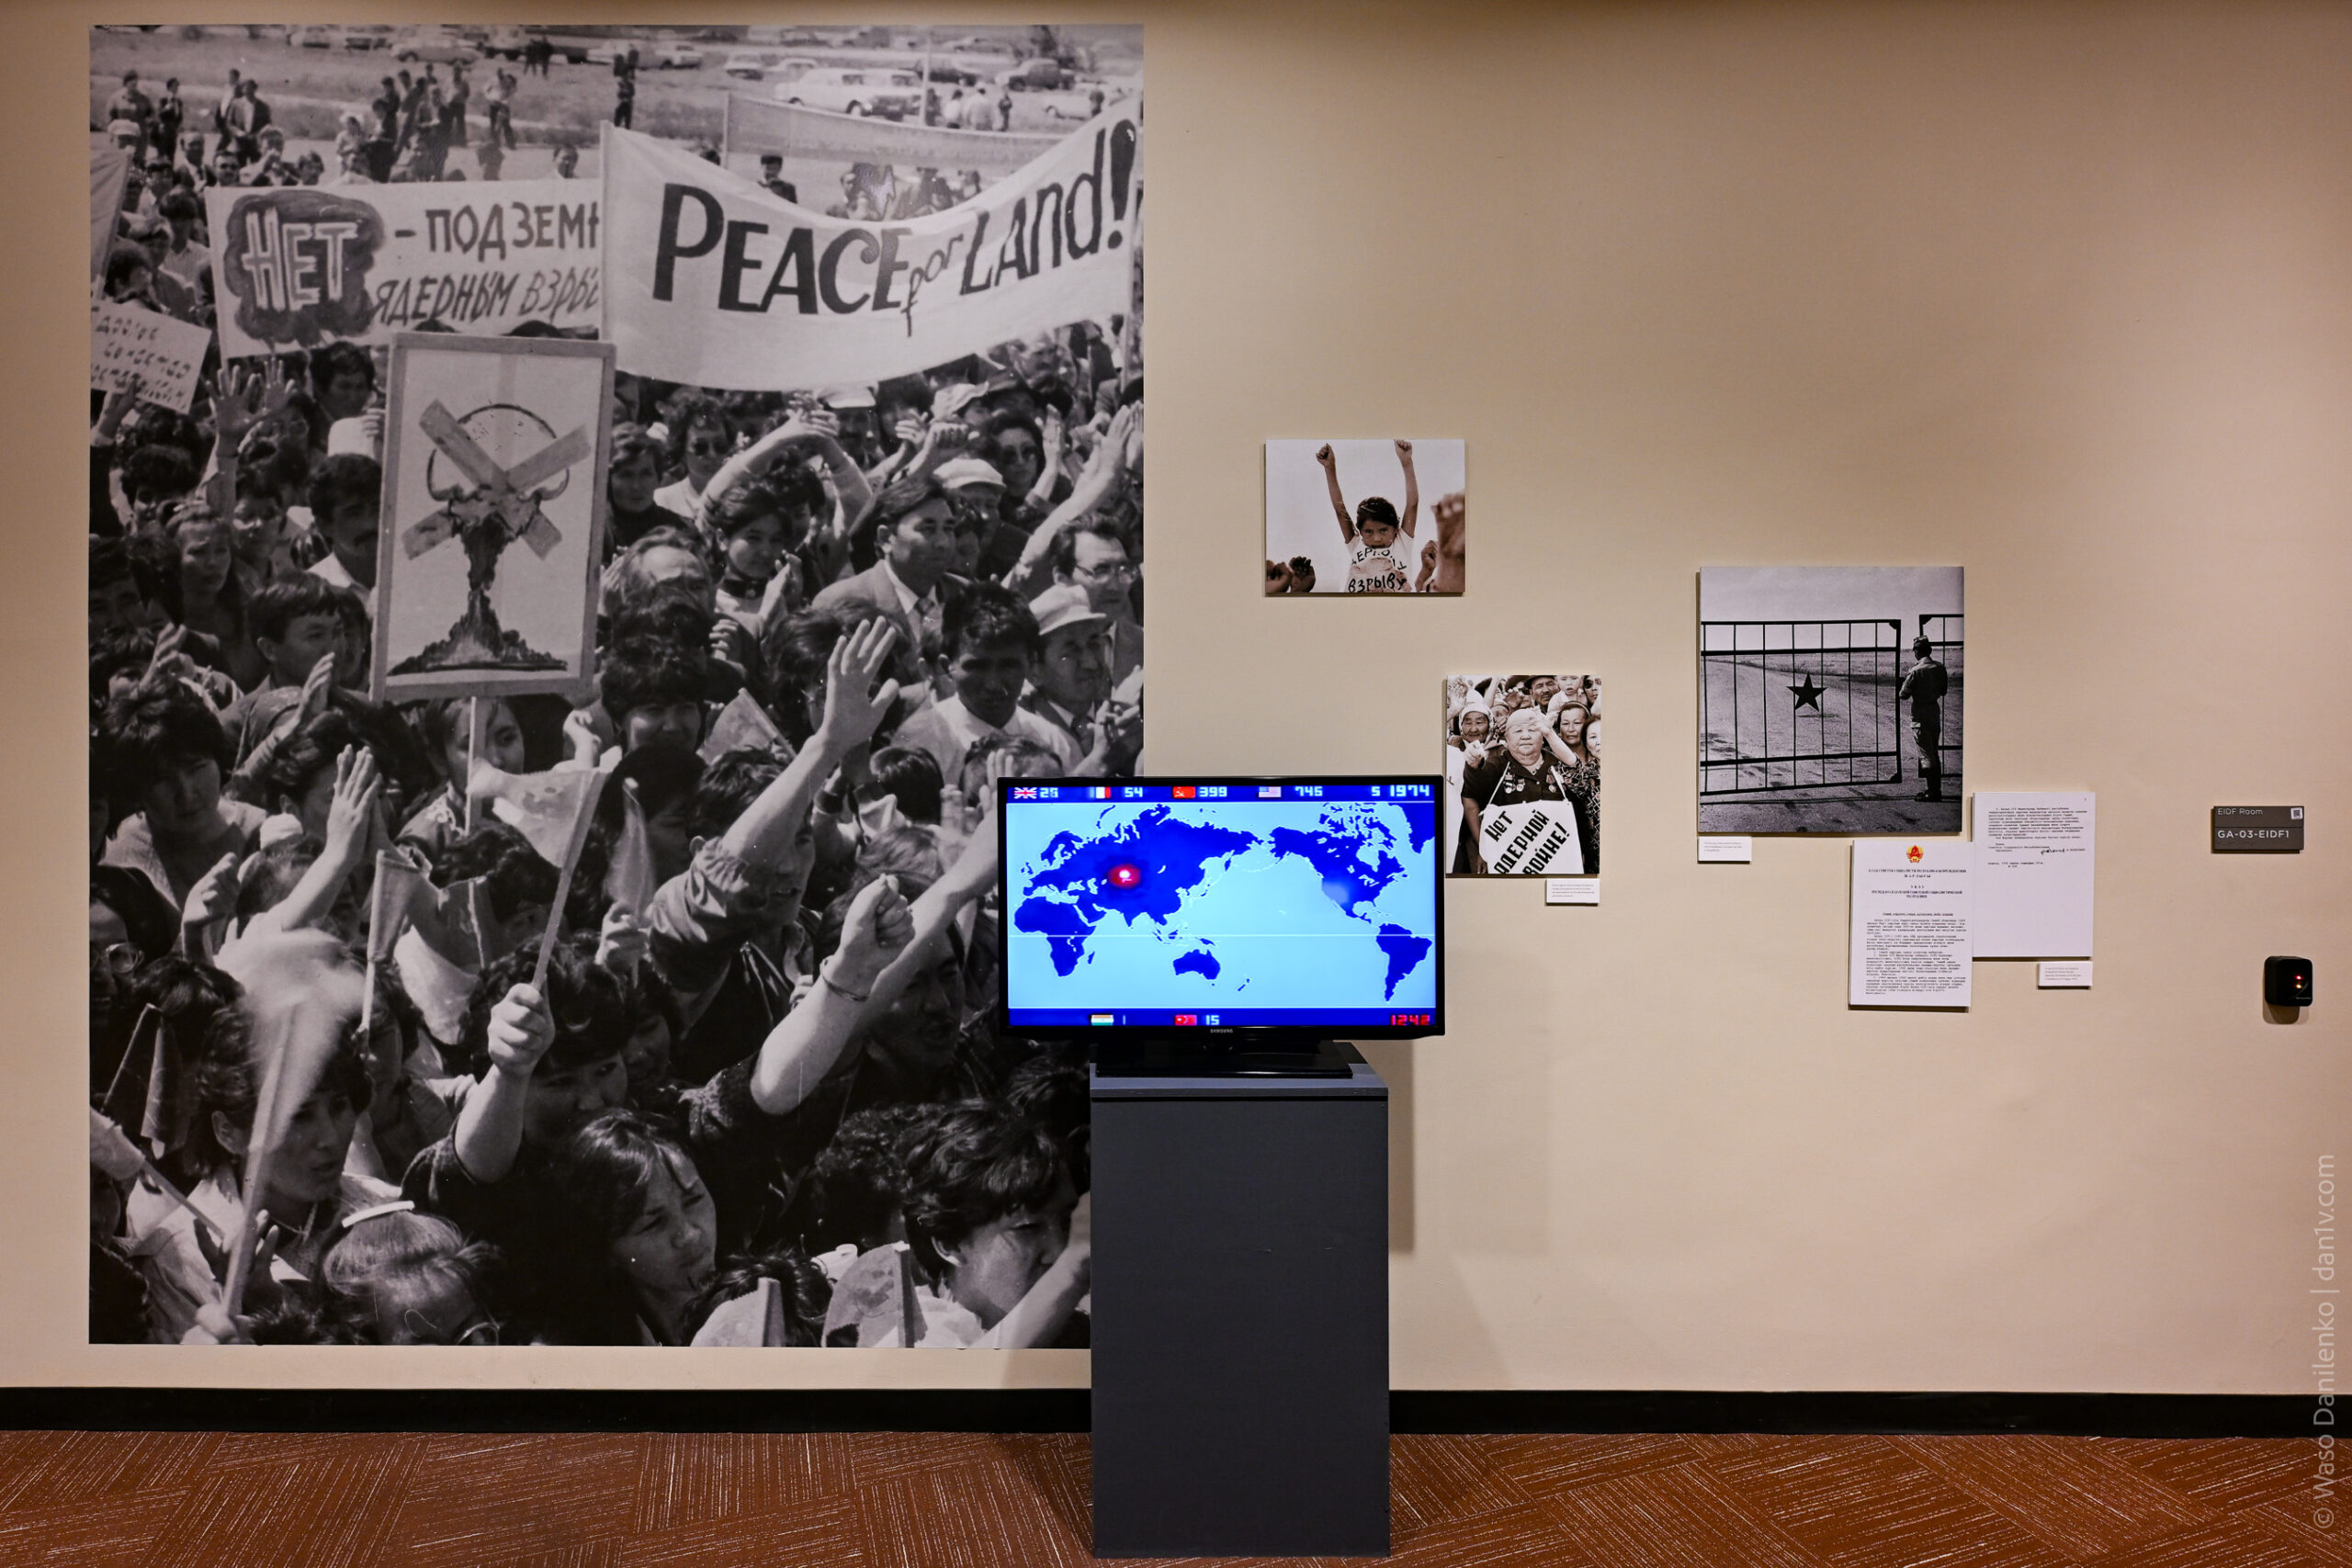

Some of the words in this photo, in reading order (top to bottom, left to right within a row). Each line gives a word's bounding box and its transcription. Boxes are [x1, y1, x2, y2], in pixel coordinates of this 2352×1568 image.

[241, 205, 359, 312] НЕТ
[651, 183, 912, 315] PEACE
[900, 233, 964, 338] for
[368, 271, 520, 326] ЯДЕРНЫМ
[1124, 786, 1144, 797] 54
[1199, 786, 1227, 797] 399
[1390, 784, 1430, 797] 1974
[2217, 807, 2236, 816] EIDF
[2239, 807, 2263, 816] Room
[1521, 821, 1570, 874] ВОЙНЕ!
[2217, 829, 2290, 839] GA-03-EIDF1
[1205, 1014, 1220, 1025] 15
